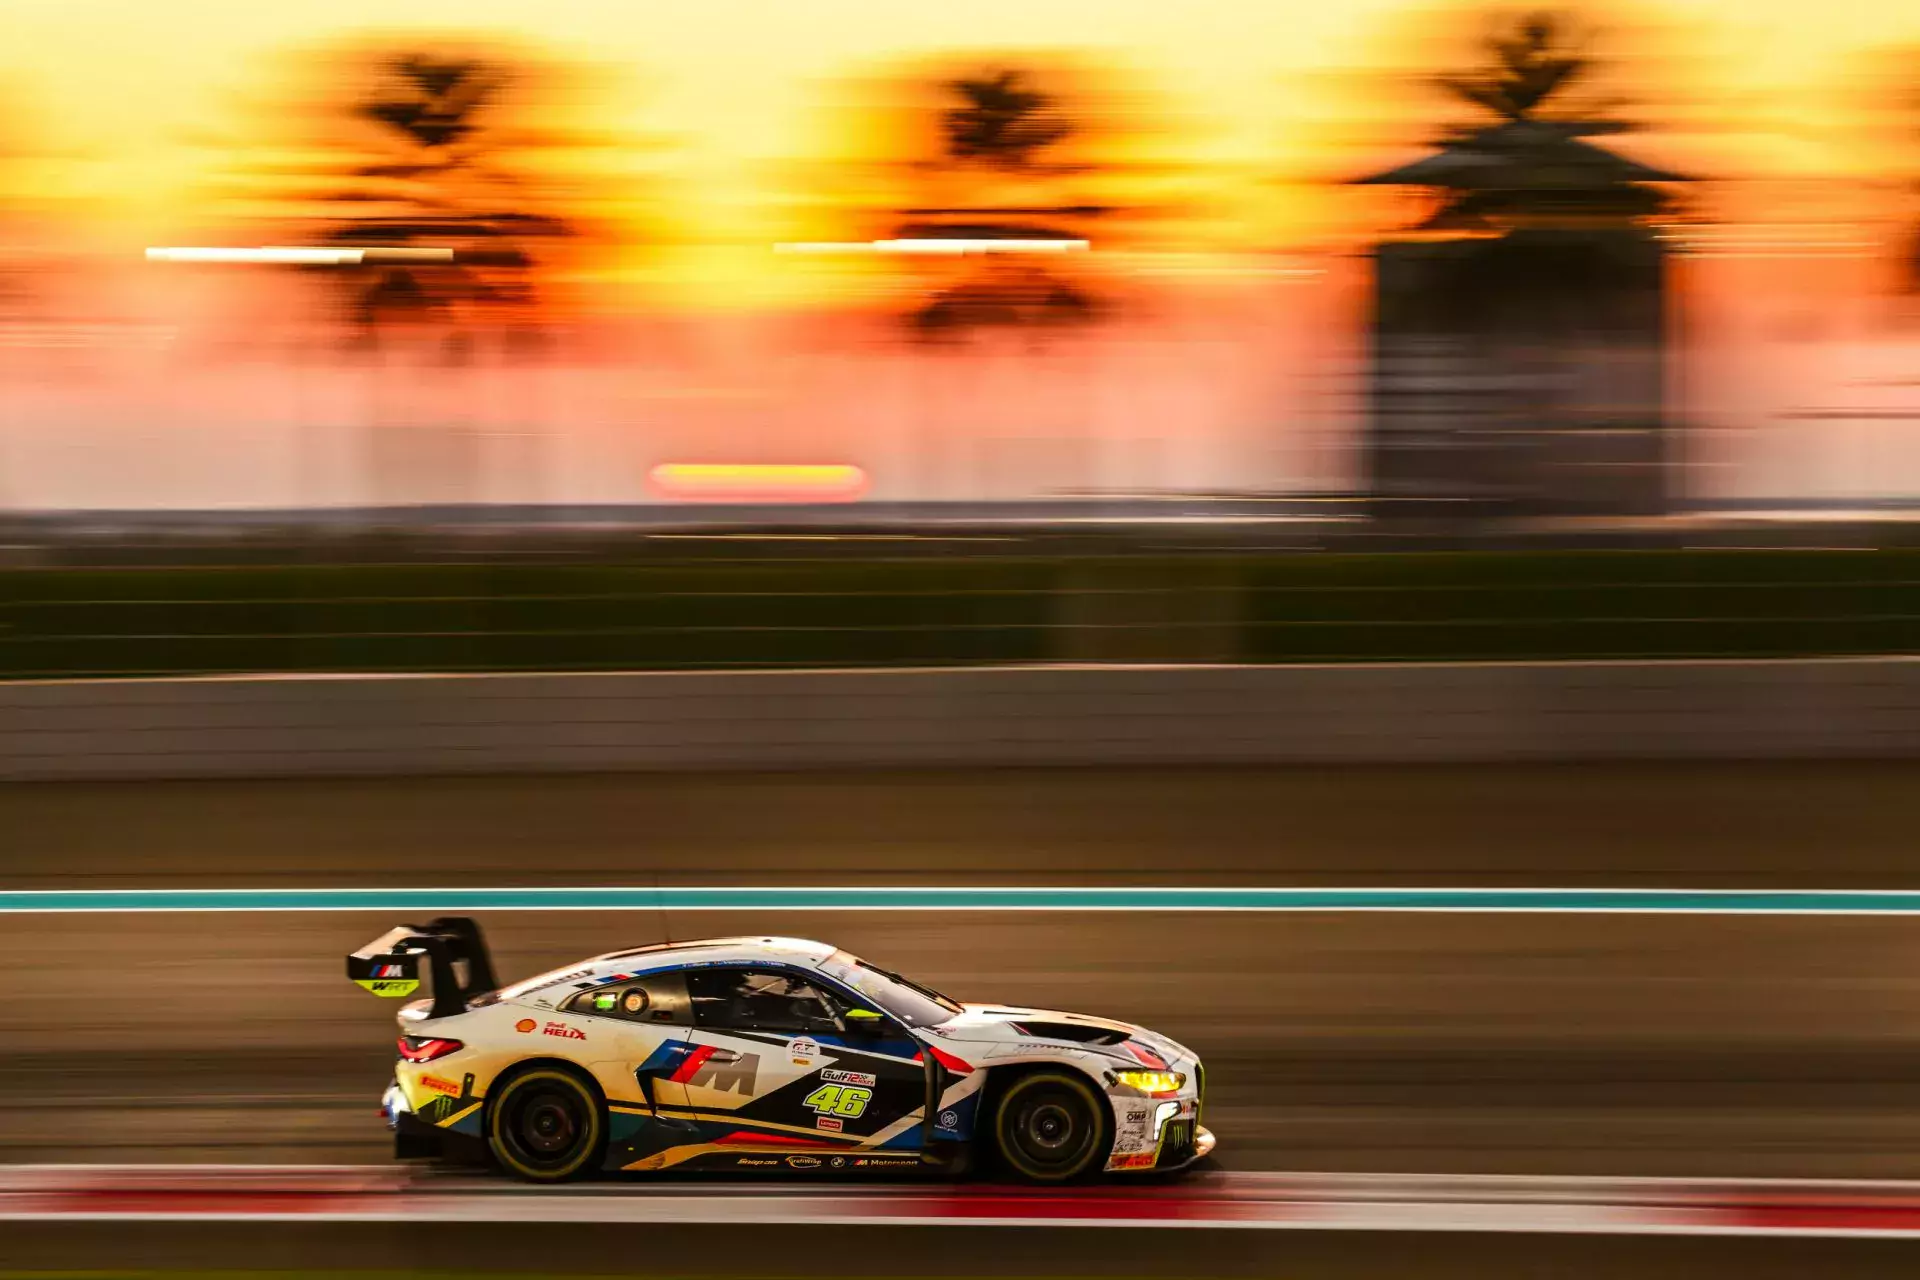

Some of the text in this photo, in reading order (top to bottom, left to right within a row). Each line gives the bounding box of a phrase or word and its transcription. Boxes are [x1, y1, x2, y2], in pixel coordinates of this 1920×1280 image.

[372, 982, 408, 990] WRT
[543, 1028, 587, 1040] HELIX
[803, 1083, 873, 1119] 46
